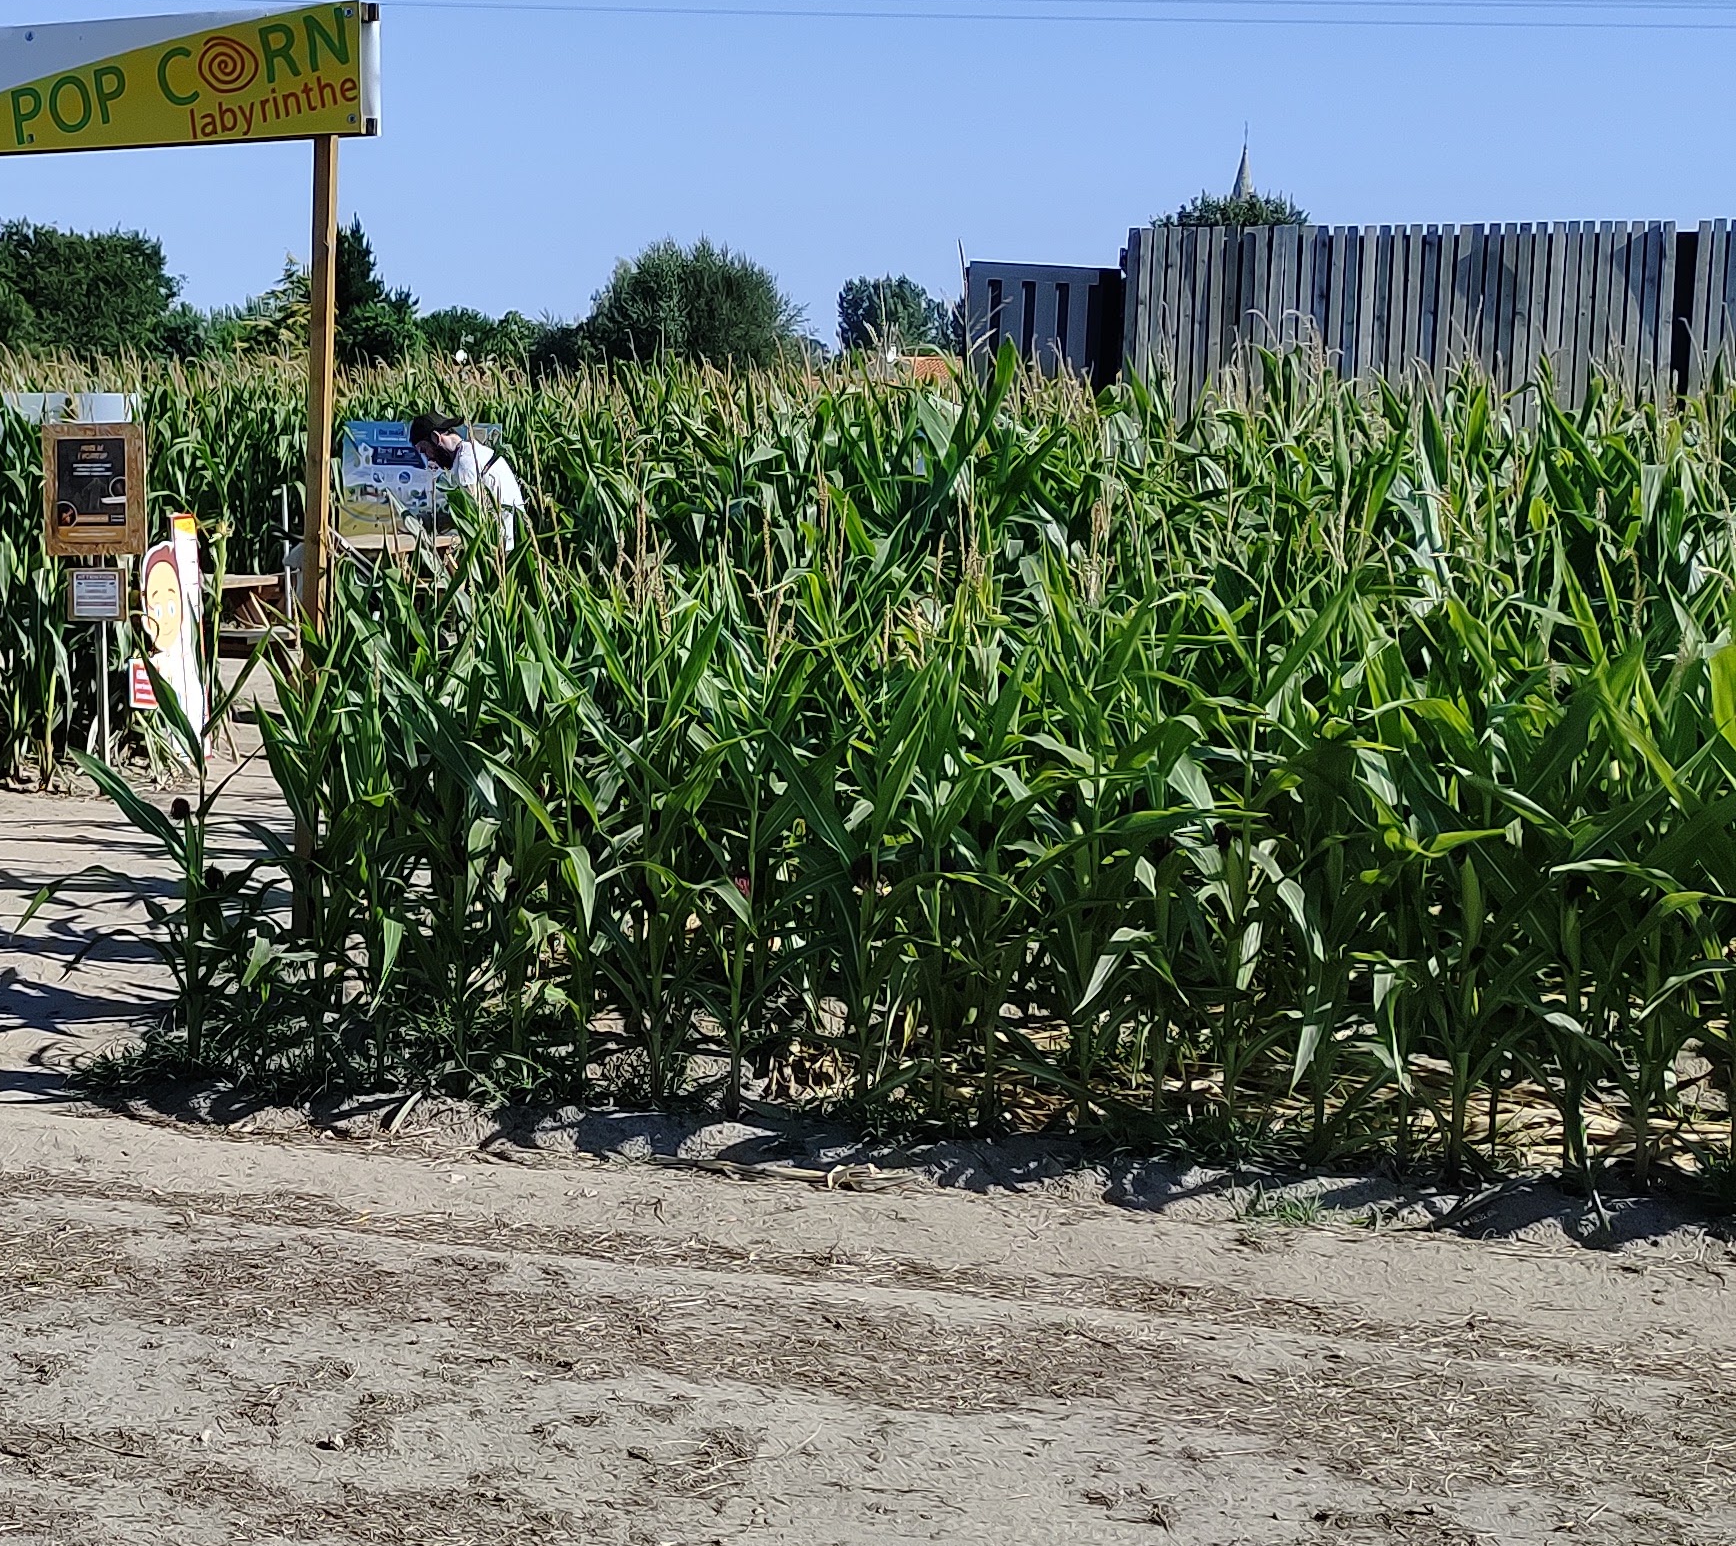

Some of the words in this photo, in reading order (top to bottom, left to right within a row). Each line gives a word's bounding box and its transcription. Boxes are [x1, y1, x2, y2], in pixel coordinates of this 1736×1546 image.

[11, 65, 126, 146] POP
[157, 6, 351, 107] CORN
[188, 75, 359, 141] labyrinthe
